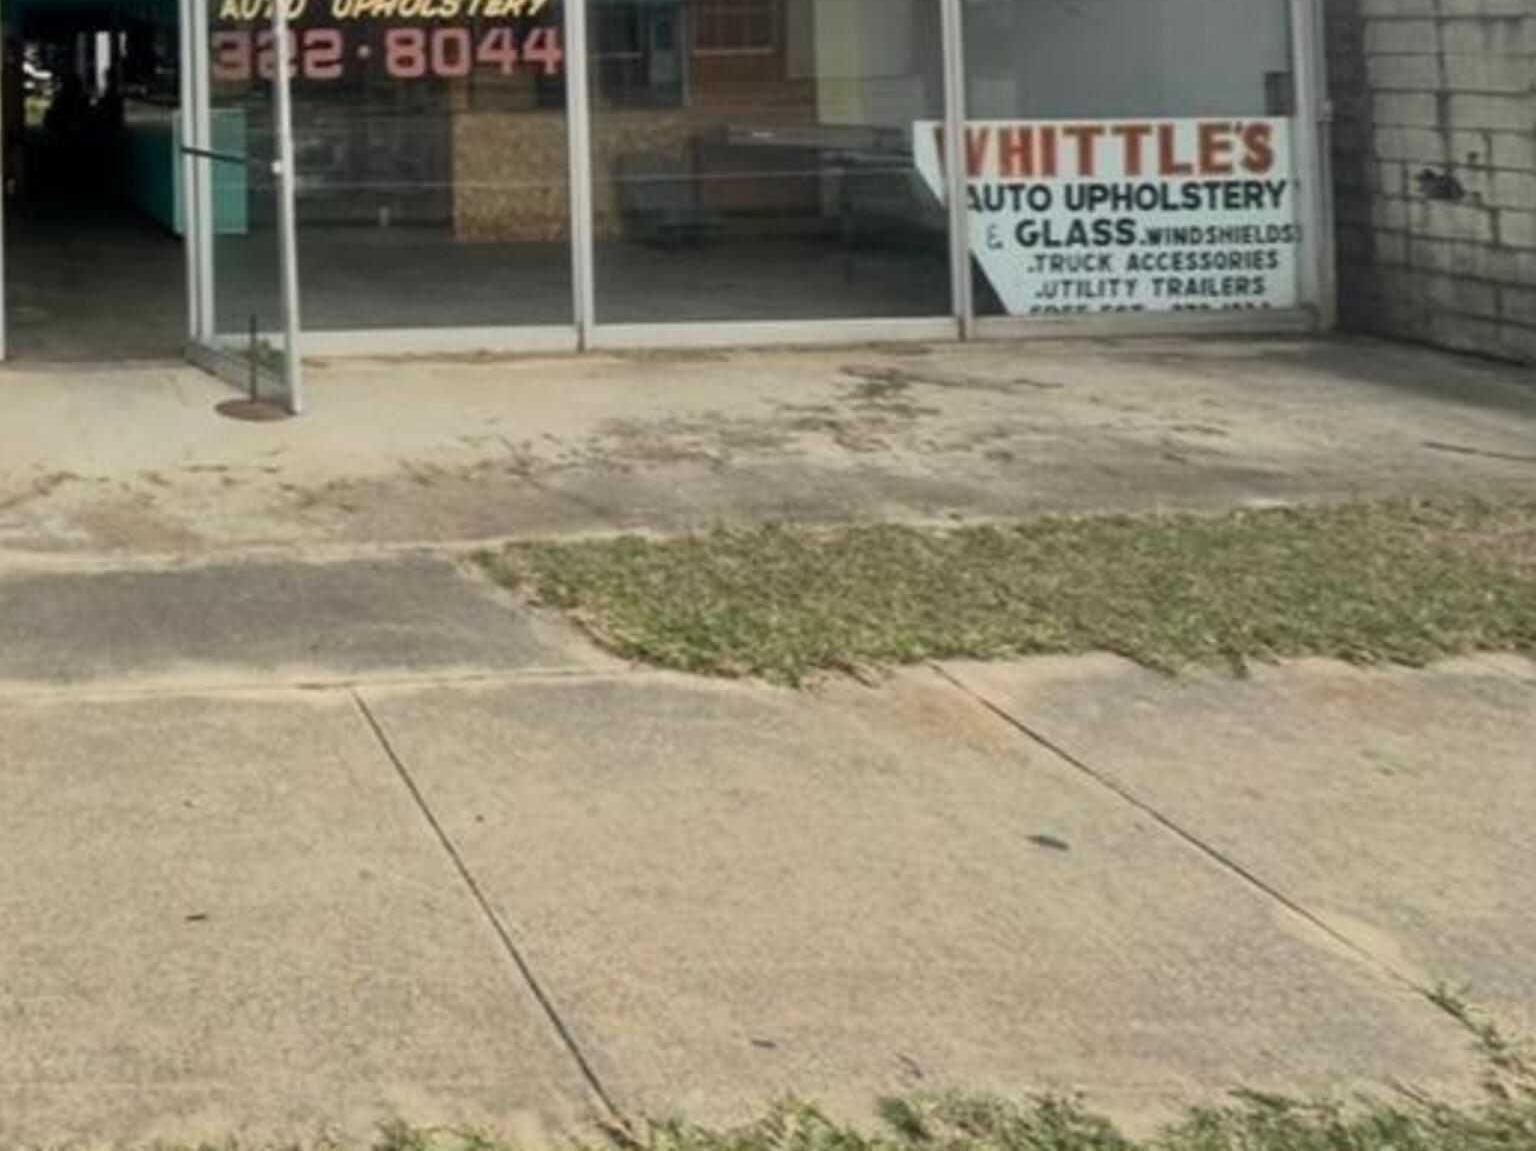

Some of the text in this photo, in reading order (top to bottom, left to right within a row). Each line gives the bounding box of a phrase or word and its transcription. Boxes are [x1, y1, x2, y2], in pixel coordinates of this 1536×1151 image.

[933, 123, 1276, 178] WHITTLE'S
[1065, 179, 1287, 211] UPHOLSTERY
[1126, 248, 1279, 271] ACCESSORIES
[1151, 275, 1266, 297] TRAILERS
